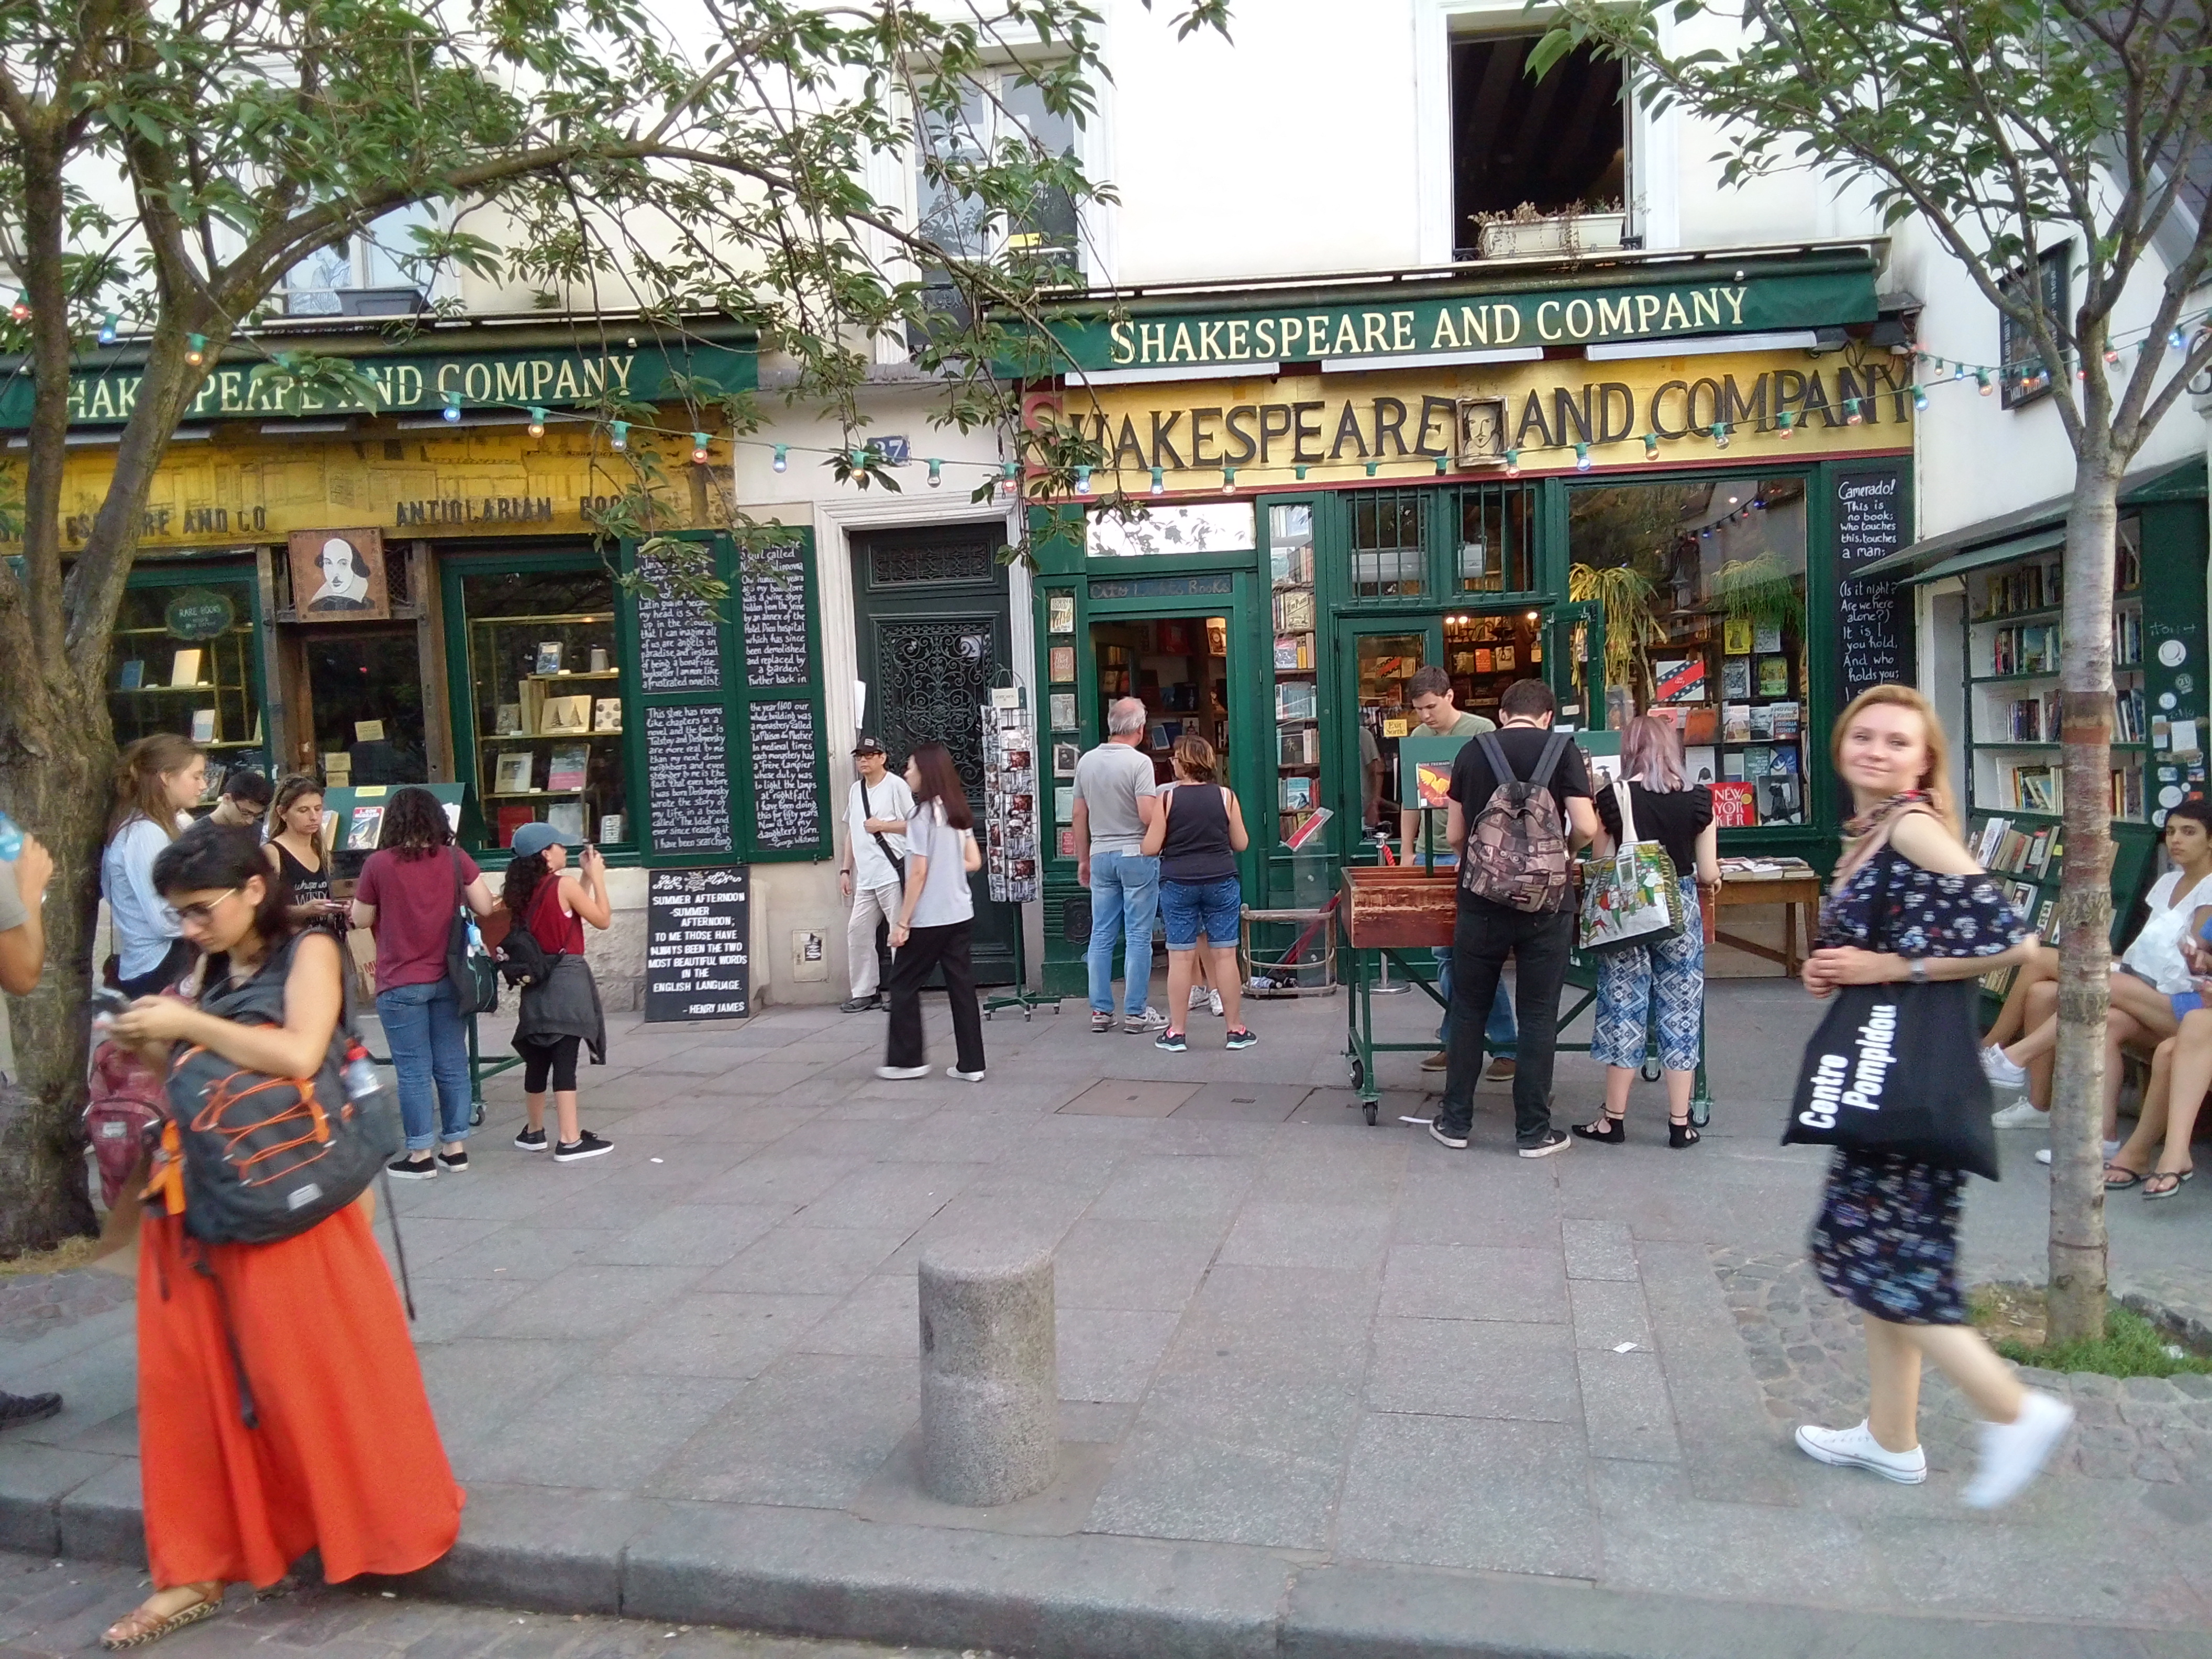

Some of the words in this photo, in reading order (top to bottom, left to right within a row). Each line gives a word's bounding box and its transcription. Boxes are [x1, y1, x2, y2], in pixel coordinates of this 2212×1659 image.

[1110, 311, 1417, 364] SHAKESPEARE
[1430, 303, 1520, 348] AND
[1536, 287, 1748, 340] COMPANY
[338, 365, 423, 408] ND
[438, 354, 635, 403] COMPANY
[1022, 394, 1457, 479] SHAKESPEARE
[1516, 382, 1635, 448] AND
[1651, 362, 1914, 441] COMPANY
[1838, 479, 1896, 500] Camerado!
[1843, 501, 1868, 513] This
[1874, 500, 1884, 511] is
[183, 507, 228, 534] AND
[1864, 511, 1894, 522] book;
[1861, 522, 1896, 531] touches
[1842, 549, 1851, 559] a
[1854, 582, 1864, 596] it
[1866, 581, 1898, 600] night?
[785, 593, 803, 604] shop
[1840, 600, 1857, 613] Are
[1859, 602, 1872, 611] we
[1872, 598, 1894, 610] here
[744, 613, 752, 624] by
[783, 610, 791, 623] of
[793, 612, 805, 621] the
[1846, 609, 1890, 623] alone?)
[643, 623, 653, 631] up
[668, 618, 681, 628] the
[640, 629, 657, 639] that
[679, 627, 705, 640] imagine
[706, 627, 717, 636] all
[745, 634, 769, 644] which
[770, 633, 783, 644] has
[786, 634, 805, 643] since
[1843, 627, 1852, 640] It
[1860, 625, 1872, 637] is
[746, 646, 762, 655] been
[764, 643, 807, 654] demolished
[1845, 641, 1865, 655] you
[1869, 635, 1898, 650] hold,
[747, 656, 759, 665] and
[760, 654, 794, 666] replaced
[796, 654, 806, 668] by
[1843, 652, 1867, 668] And
[1874, 653, 1894, 665] who
[766, 663, 803, 676] garden.
[1848, 667, 1877, 682] holds
[748, 674, 775, 686] Further
[776, 673, 795, 684] back
[797, 673, 807, 683] in
[646, 707, 665, 718] This
[666, 707, 683, 718] store
[684, 707, 698, 716] has
[750, 702, 762, 712] the
[762, 704, 777, 713] year
[777, 701, 792, 711] 1600
[665, 717, 700, 728] chapters
[647, 727, 667, 736] novel
[669, 725, 684, 735] and
[686, 726, 698, 734] the
[699, 725, 713, 735] fact
[716, 725, 724, 733] is
[686, 744, 702, 753] real
[753, 743, 759, 751] In
[761, 740, 789, 751] medieval
[792, 740, 813, 750] times
[754, 770, 775, 779] whose
[776, 769, 796, 782] duty
[755, 781, 762, 790] to
[764, 779, 782, 793] light
[784, 779, 795, 789] the
[797, 779, 817, 793] lamps
[760, 791, 771, 800] at
[1715, 788, 1744, 801] NEW
[798, 819, 812, 829] my
[660, 838, 677, 848] have
[678, 837, 695, 847] been
[696, 836, 733, 851] searching
[652, 894, 691, 905] SUMMER
[694, 892, 745, 903] AFTERNOON
[655, 933, 666, 942] TO
[668, 931, 682, 942] ME
[684, 931, 713, 941] THOSE
[714, 930, 738, 939] HAVE
[650, 945, 682, 956] ALWAYS
[684, 944, 705, 954] BEEN
[707, 943, 723, 953] THE
[724, 942, 743, 952] TWO
[648, 958, 672, 968] MOST
[673, 956, 718, 967] BEAUTIFUL
[718, 955, 748, 965] WORDS
[681, 969, 691, 979] IN
[694, 968, 710, 978] THE
[652, 981, 692, 993] ENGLISH
[689, 1003, 716, 1014] HENRY
[716, 1001, 745, 1013] JAMES
